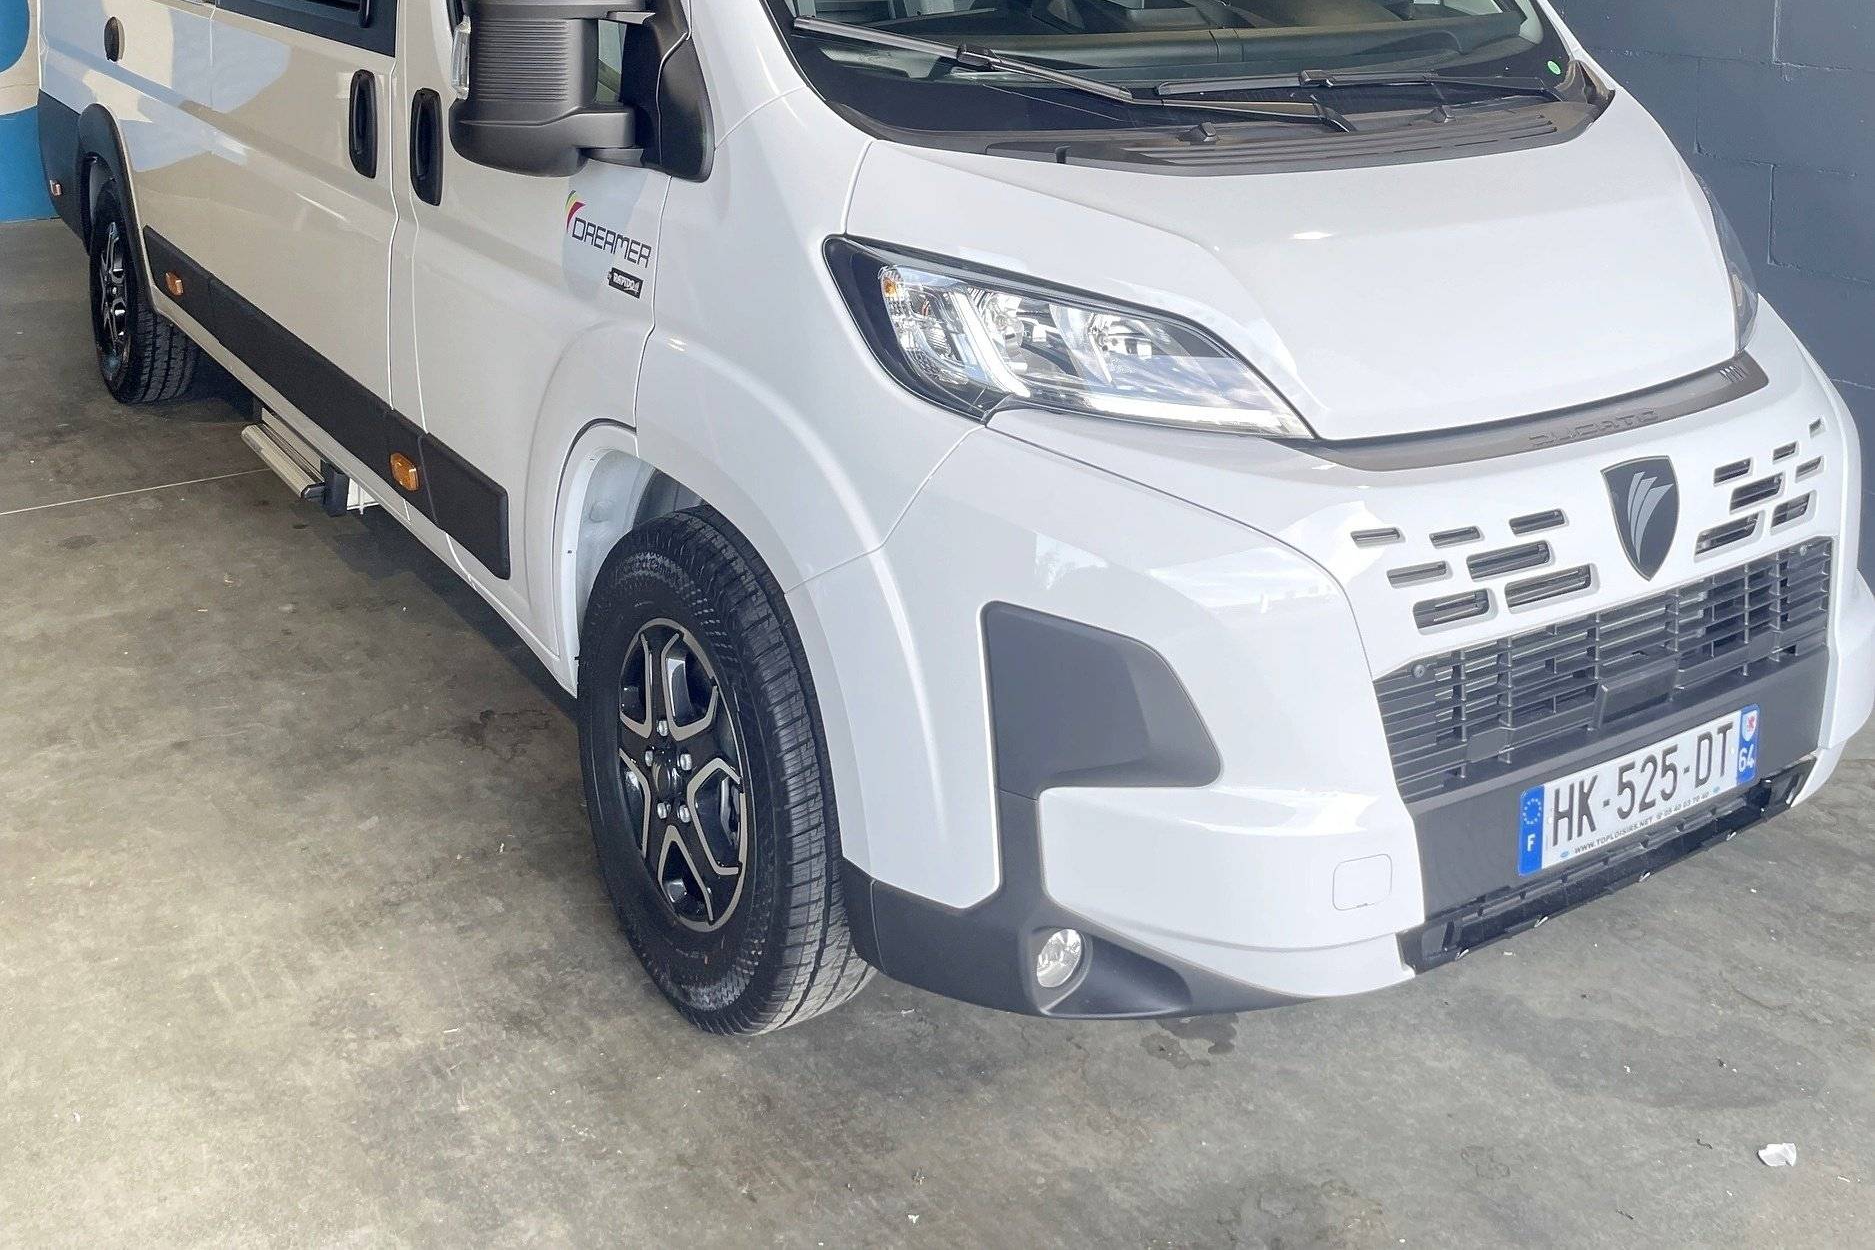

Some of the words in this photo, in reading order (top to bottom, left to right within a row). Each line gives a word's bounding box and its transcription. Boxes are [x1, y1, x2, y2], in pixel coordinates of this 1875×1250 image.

[572, 217, 651, 268] DREAMER
[1738, 747, 1755, 772] 64
[1552, 721, 1734, 847] HK-525-DT
[1526, 833, 1536, 852] F
